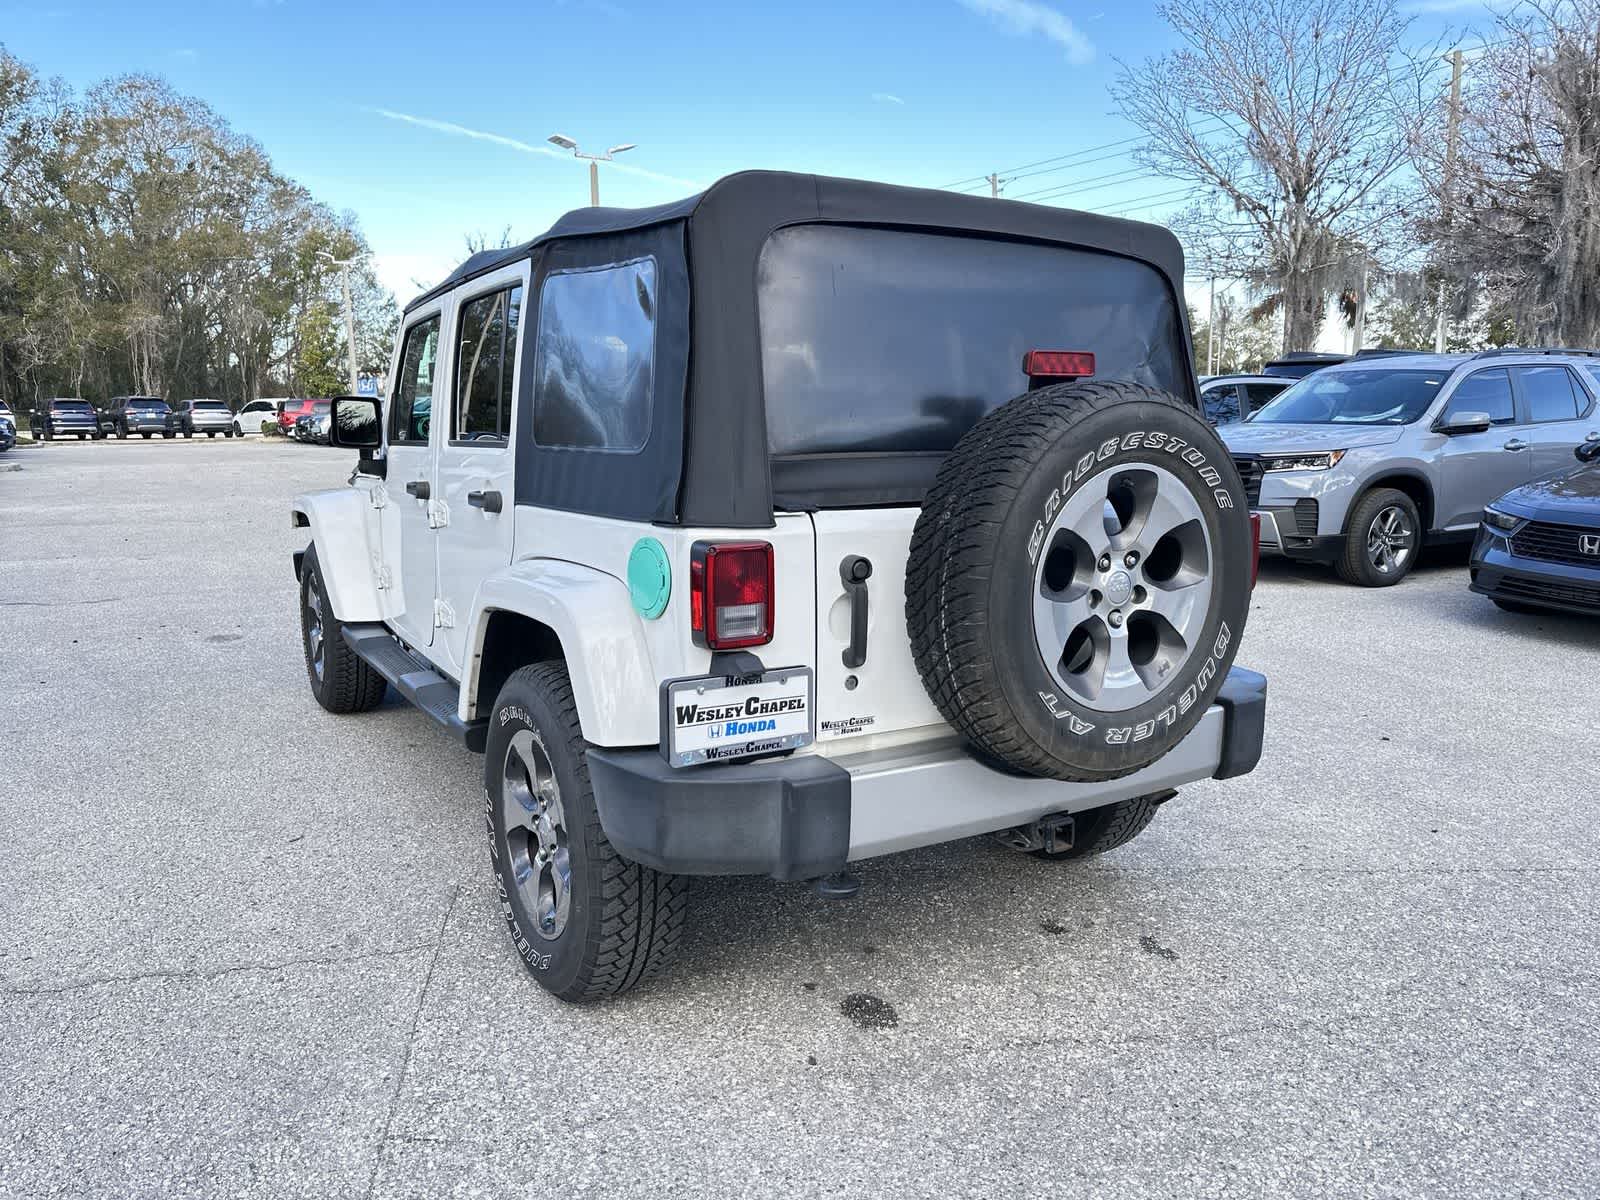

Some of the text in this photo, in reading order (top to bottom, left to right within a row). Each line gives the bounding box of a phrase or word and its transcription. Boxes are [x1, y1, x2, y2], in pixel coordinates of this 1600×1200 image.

[1027, 431, 1234, 566] BRIDGESTONE
[1039, 621, 1232, 745] DUELER A/T
[676, 696, 805, 725] WESLEY CHAPEL
[725, 719, 776, 736] HONDA
[821, 717, 875, 729] WESLEY CHAPEL
[706, 742, 783, 759] WESLEY CHAPEL
